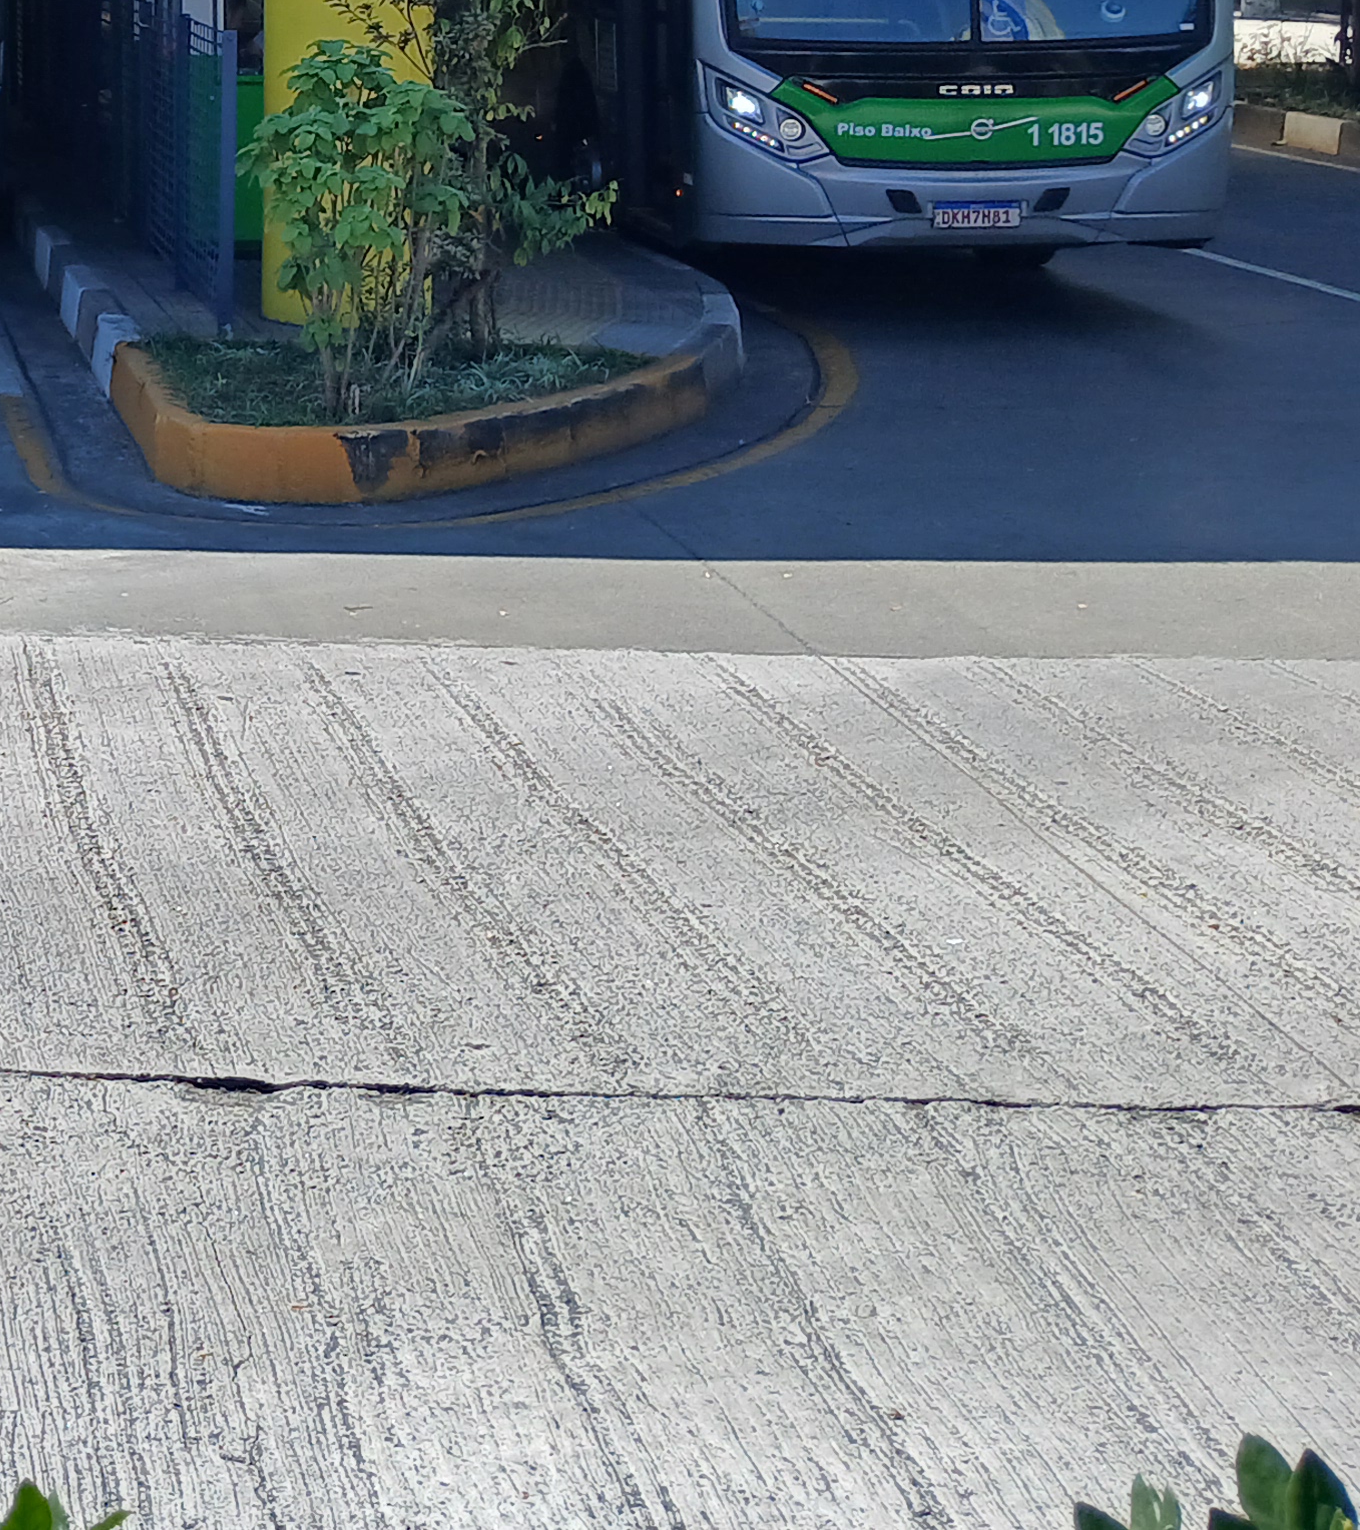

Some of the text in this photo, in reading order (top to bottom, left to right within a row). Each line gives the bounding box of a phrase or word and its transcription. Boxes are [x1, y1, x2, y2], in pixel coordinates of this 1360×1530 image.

[836, 122, 933, 139] Piso Baixo
[1026, 122, 1105, 147] 1 1815
